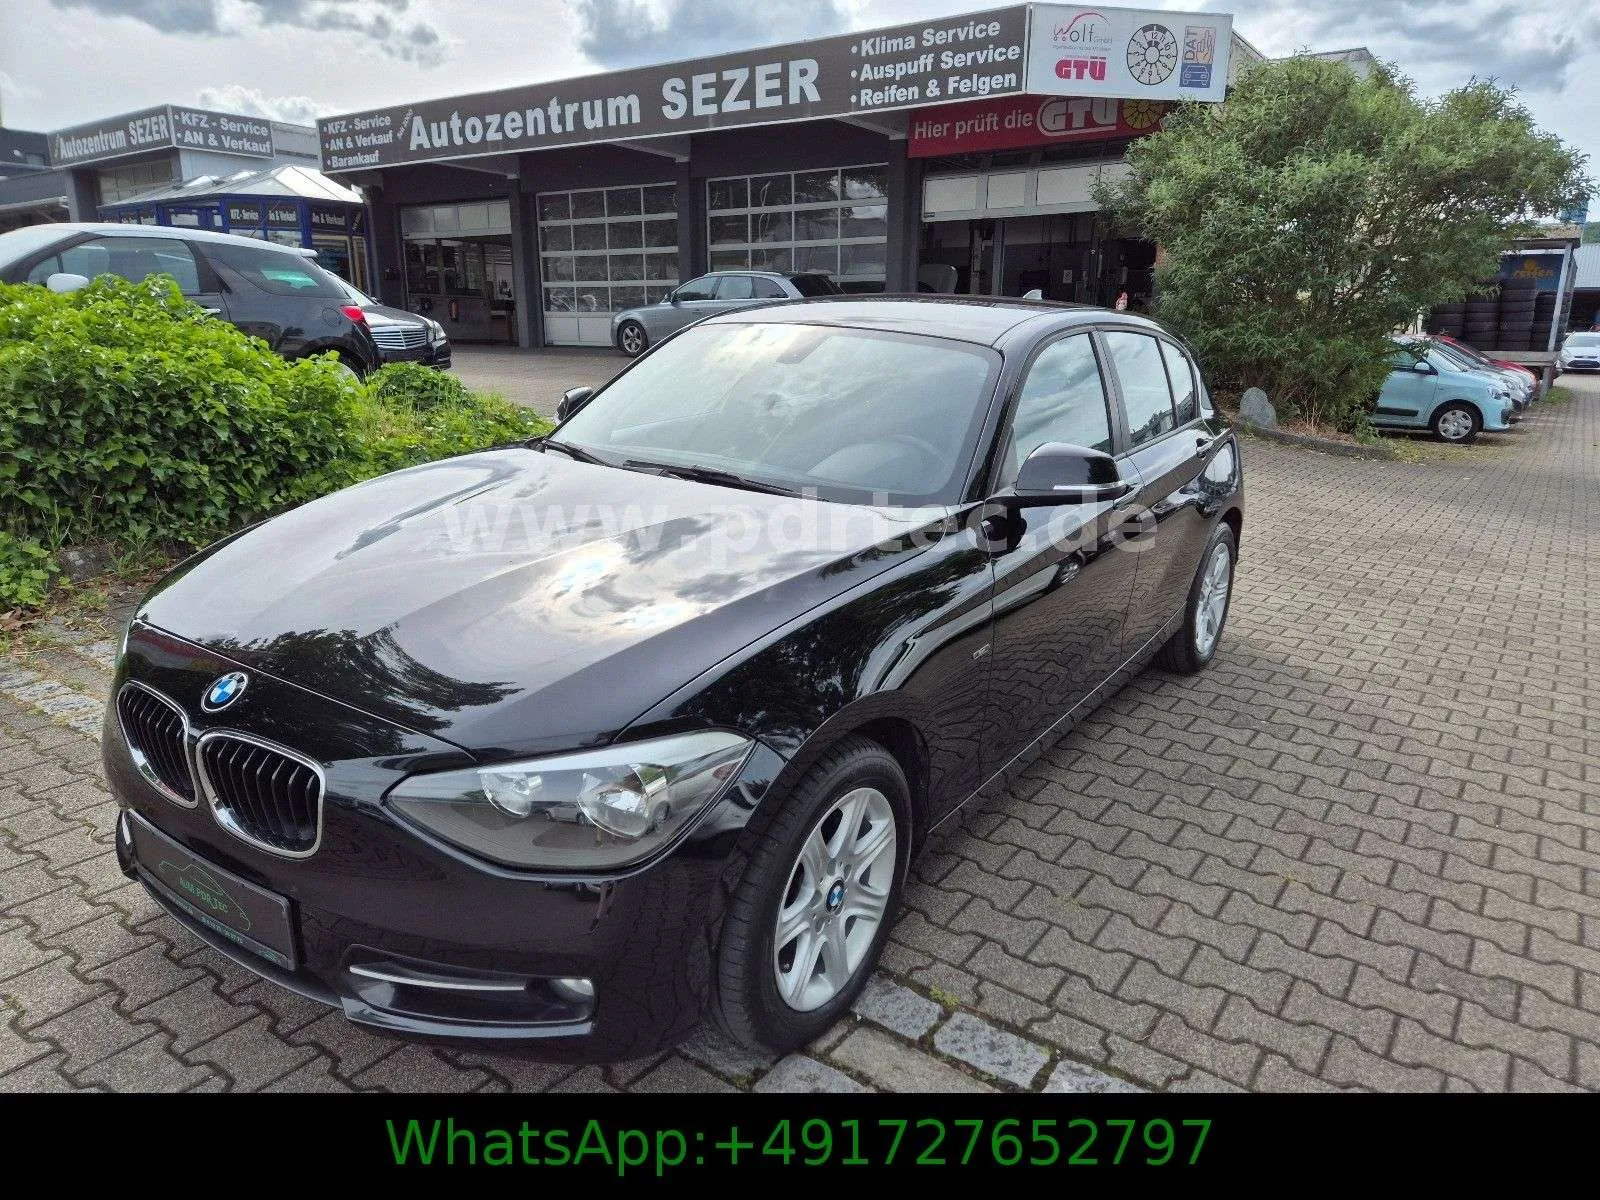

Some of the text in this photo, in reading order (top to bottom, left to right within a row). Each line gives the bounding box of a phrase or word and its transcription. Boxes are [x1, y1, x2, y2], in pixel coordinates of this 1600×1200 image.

[861, 21, 1001, 57] Klima Service
[860, 45, 1021, 82] Auspuff Service
[1055, 56, 1107, 80] GTÜ
[860, 72, 1017, 107] Reifen & Felgen
[410, 93, 641, 151] Autozentrum
[662, 58, 821, 121] SEZER
[59, 128, 126, 160] Autozentrum
[129, 114, 168, 144] SEZER
[181, 111, 210, 129] KFZ
[220, 119, 269, 136] Service
[328, 120, 347, 135] KFZ
[354, 115, 391, 130] Service
[914, 120, 950, 140] Hier
[955, 113, 999, 139] prüft
[1005, 110, 1033, 129] die
[184, 130, 271, 153] AN & Verkauf
[330, 130, 393, 151] AN & Verkauf
[332, 150, 379, 168] Barankauf
